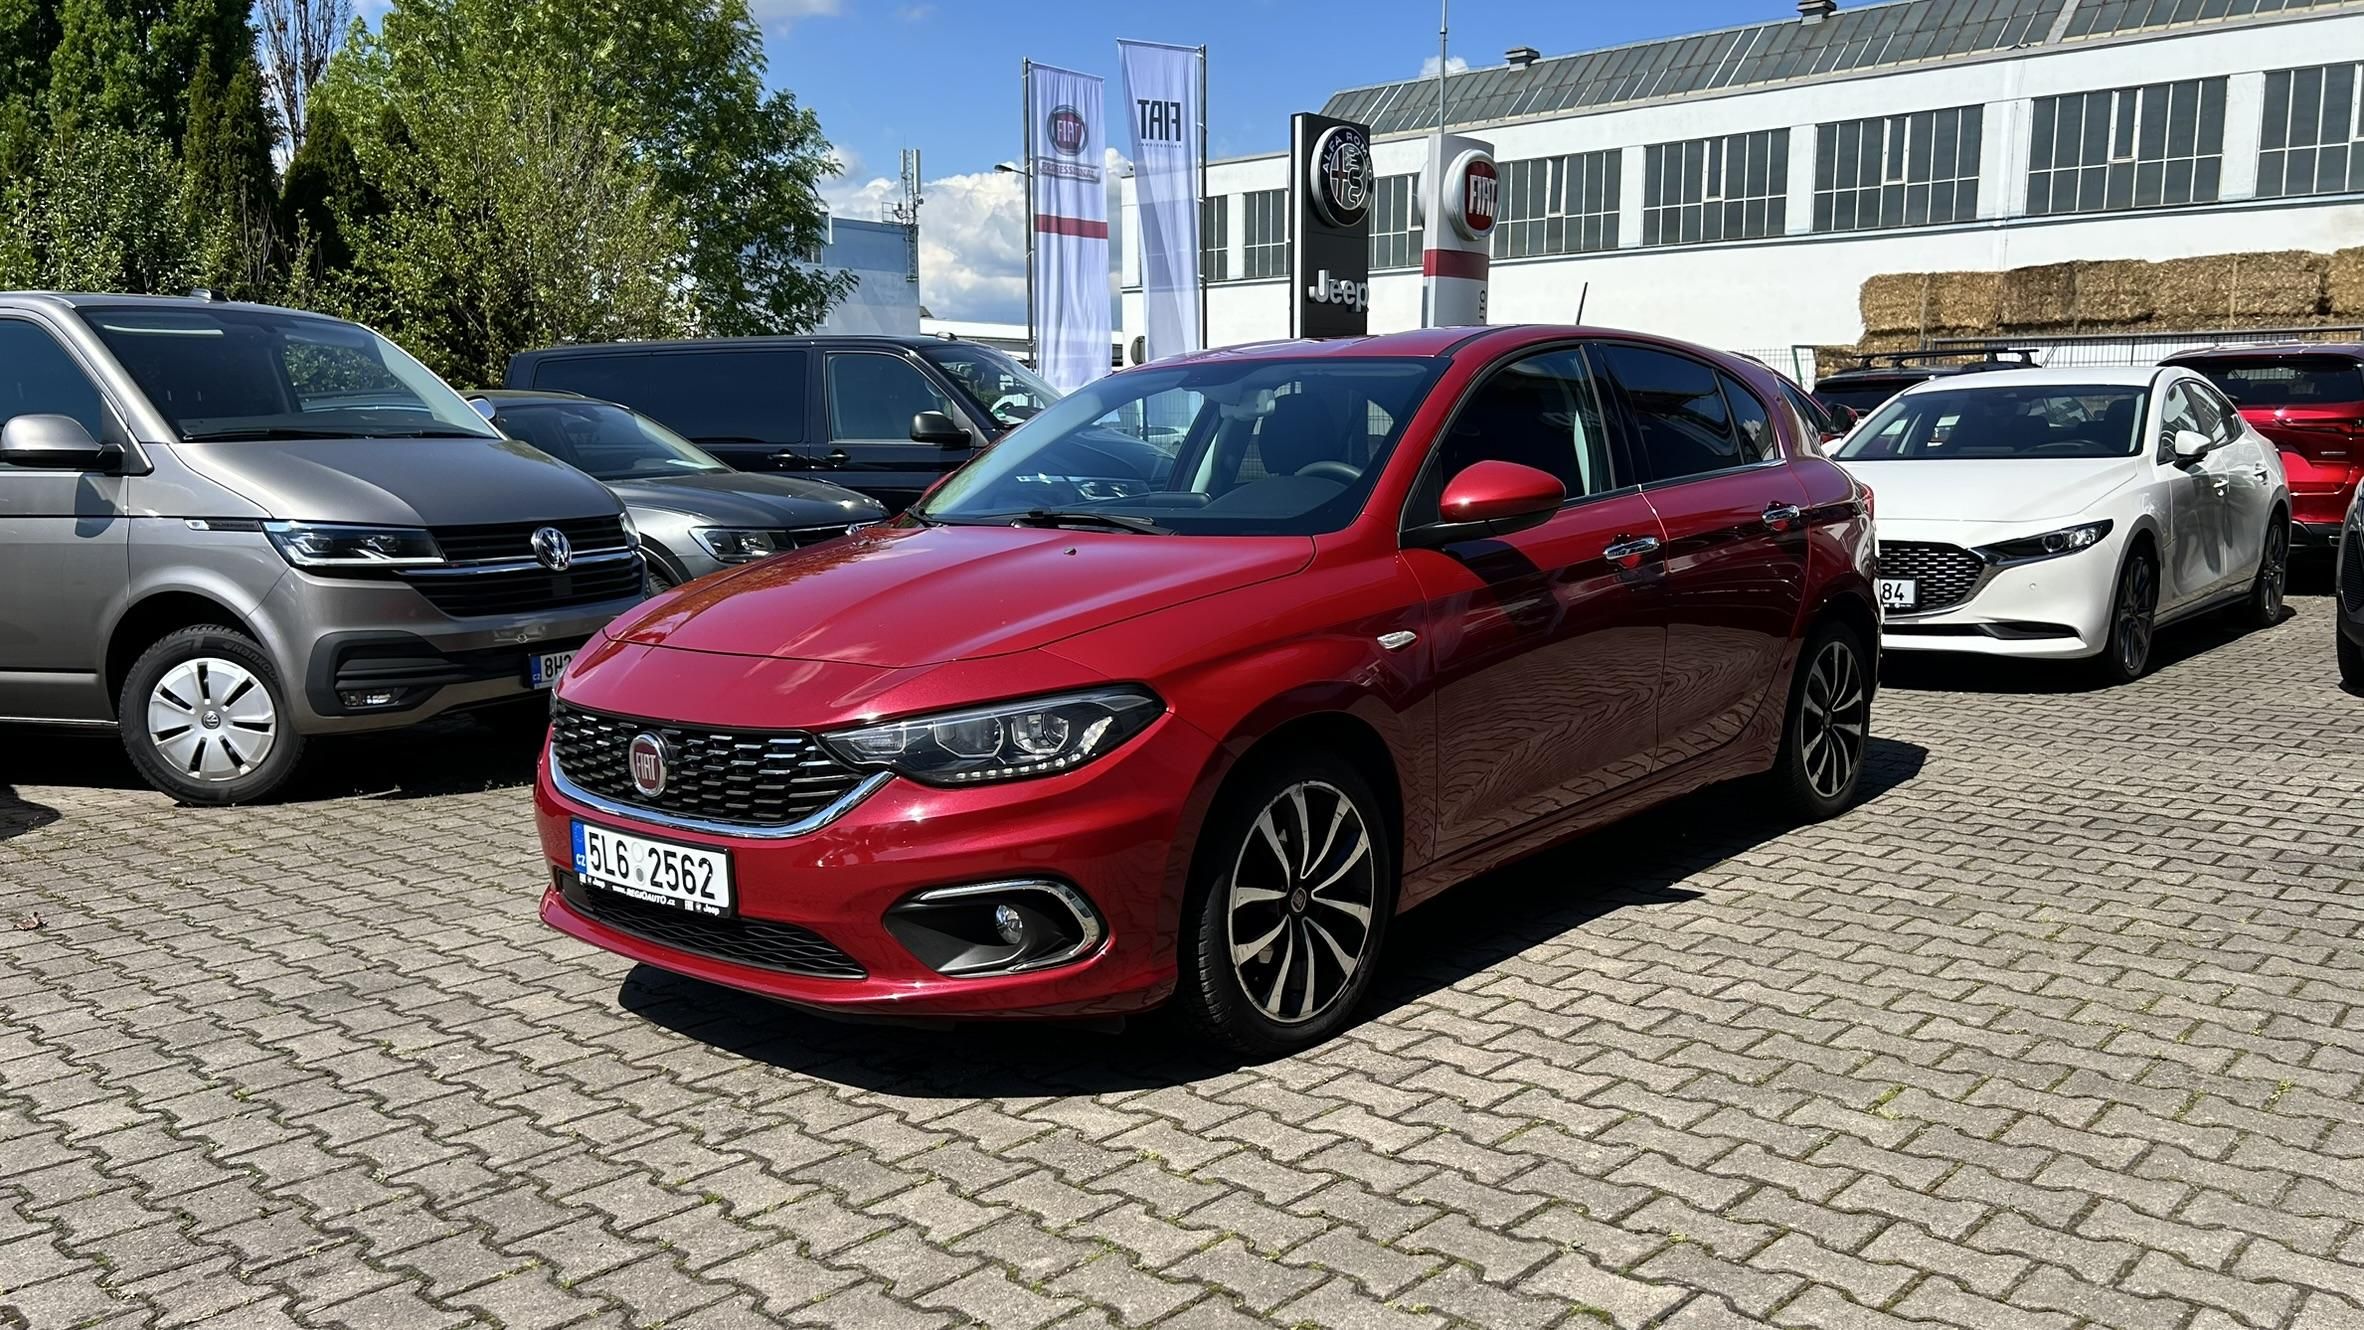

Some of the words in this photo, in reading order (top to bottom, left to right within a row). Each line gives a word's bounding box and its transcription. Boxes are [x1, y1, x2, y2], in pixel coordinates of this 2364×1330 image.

[1056, 120, 1080, 144] FIAT
[1322, 135, 1343, 174] ALFA
[1468, 174, 1497, 217] FIAT
[1308, 269, 1369, 313] Jeep
[1882, 582, 1905, 601] 84
[635, 751, 657, 781] FIAT
[576, 853, 586, 867] CZ
[589, 832, 630, 879] 5L6
[648, 847, 716, 900] 2562
